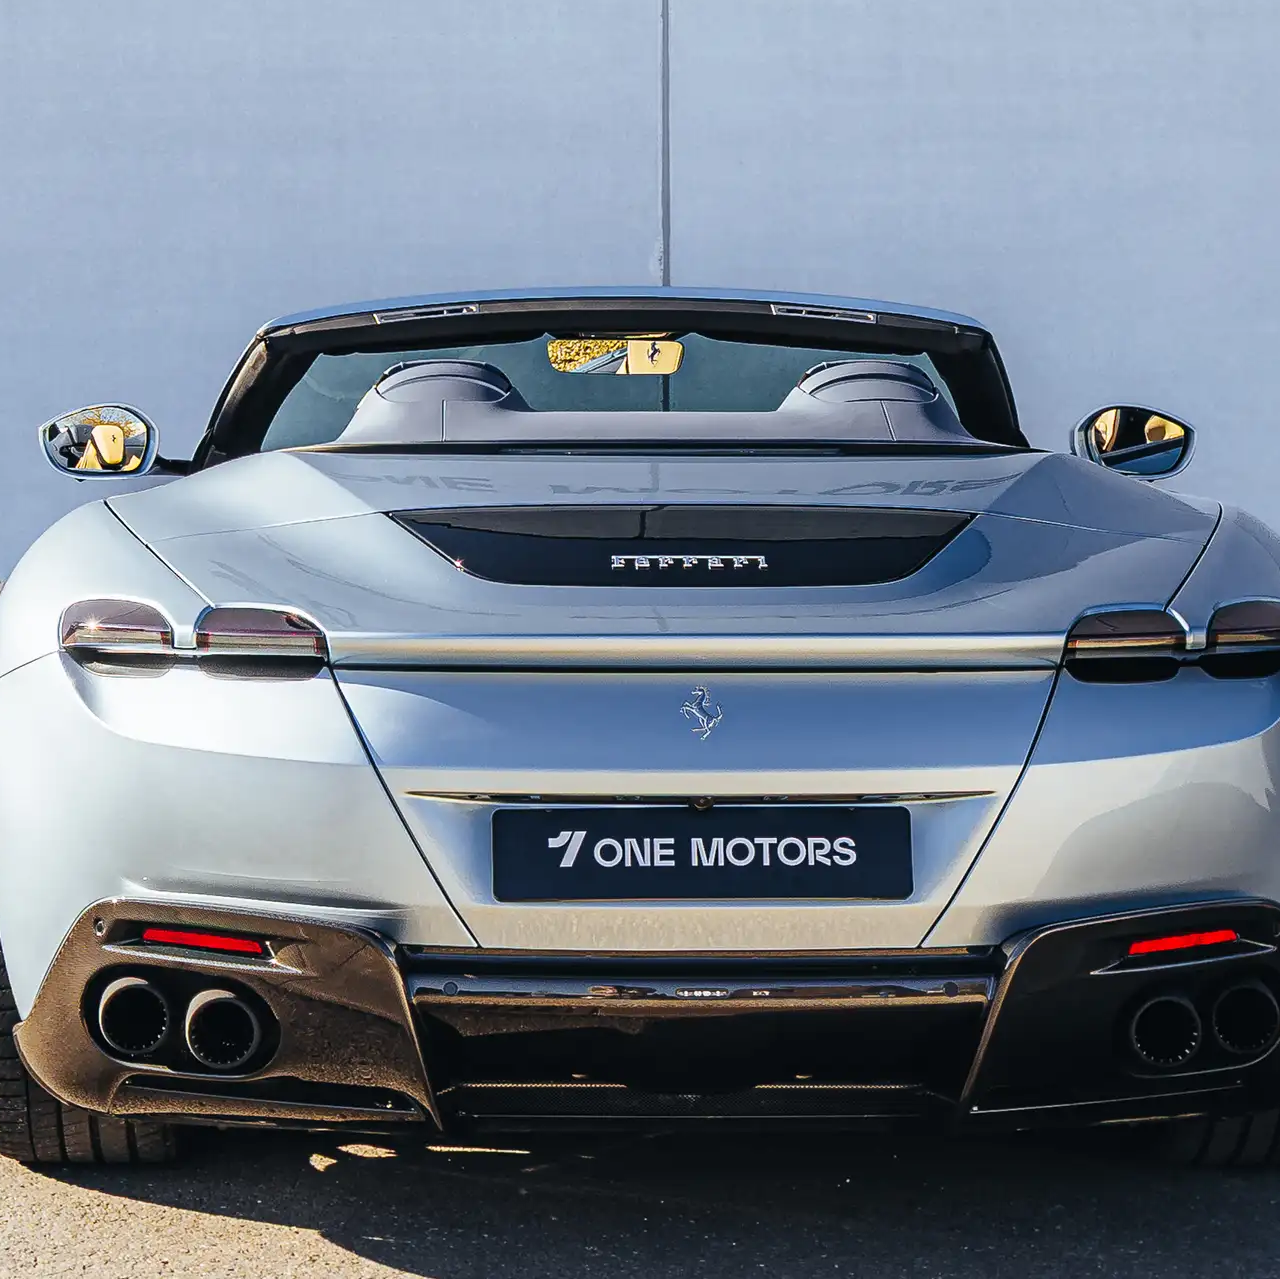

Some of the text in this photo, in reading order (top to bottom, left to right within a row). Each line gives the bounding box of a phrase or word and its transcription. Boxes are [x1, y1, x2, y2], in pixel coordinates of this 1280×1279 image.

[611, 555, 768, 570] Ferrari
[593, 837, 676, 868] ONE
[691, 837, 857, 867] MOTORS
